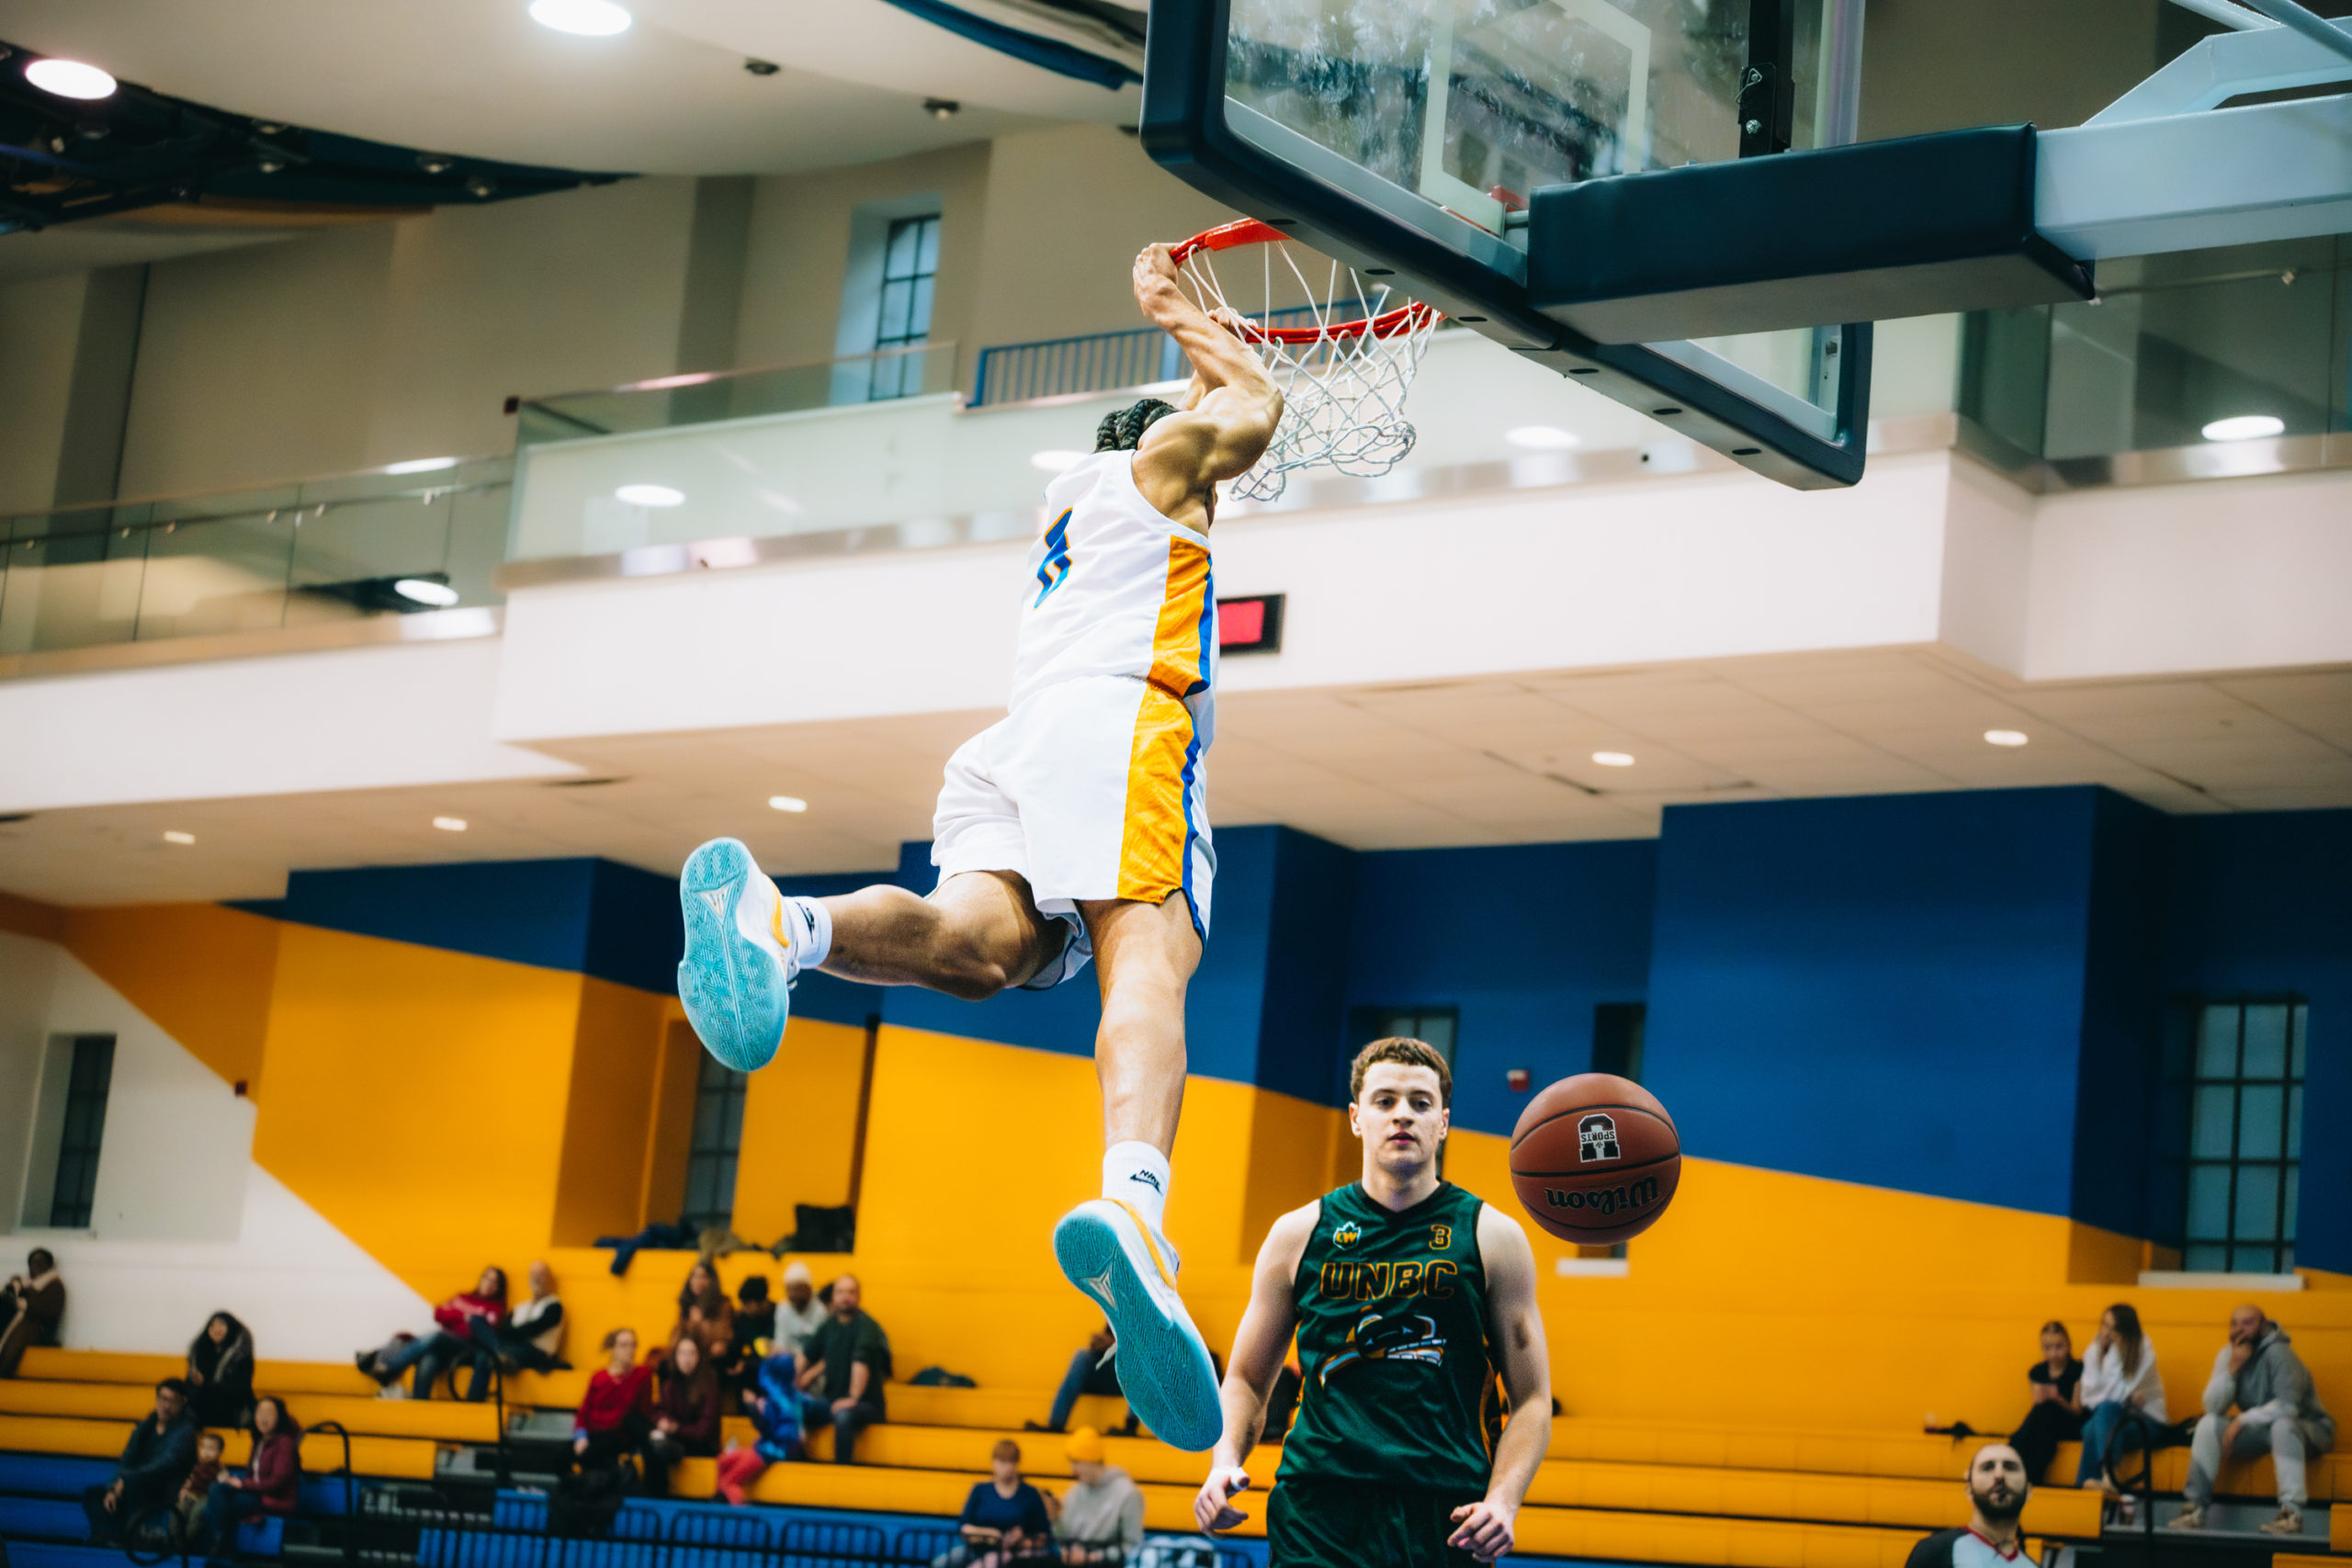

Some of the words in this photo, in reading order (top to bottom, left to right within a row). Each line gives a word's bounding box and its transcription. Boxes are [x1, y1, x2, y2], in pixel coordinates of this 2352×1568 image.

[1580, 1131, 1616, 1143] SPORTS
[1544, 1176, 1658, 1215] Wilson
[1429, 1224, 1452, 1250] 3
[1320, 1259, 1458, 1301] UNBC
